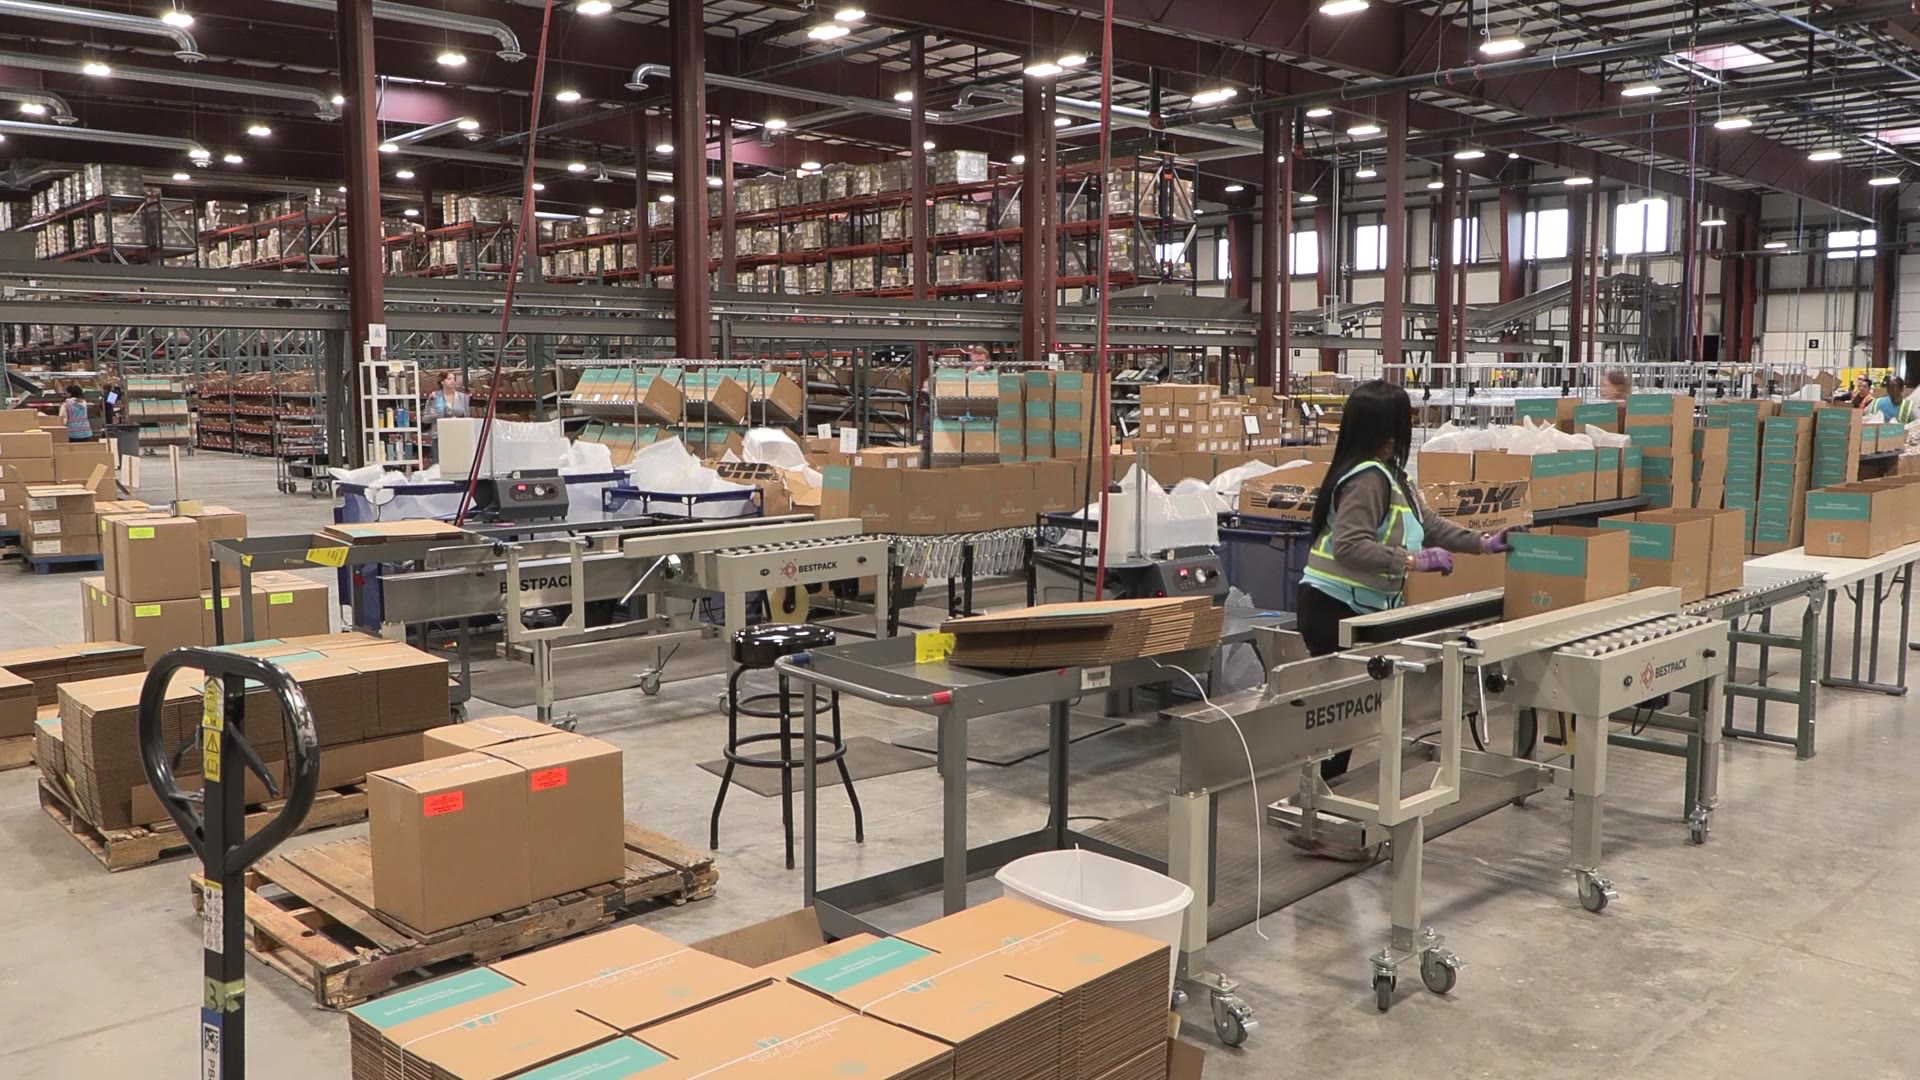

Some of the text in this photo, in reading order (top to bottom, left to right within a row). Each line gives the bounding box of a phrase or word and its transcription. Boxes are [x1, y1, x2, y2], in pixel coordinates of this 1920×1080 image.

[1455, 486, 1518, 516] DHL
[798, 561, 839, 573] BESTPACK
[500, 575, 572, 594] BSTPAC
[1655, 658, 1688, 679] BESTPACK
[1305, 692, 1382, 730] BESTPACK
